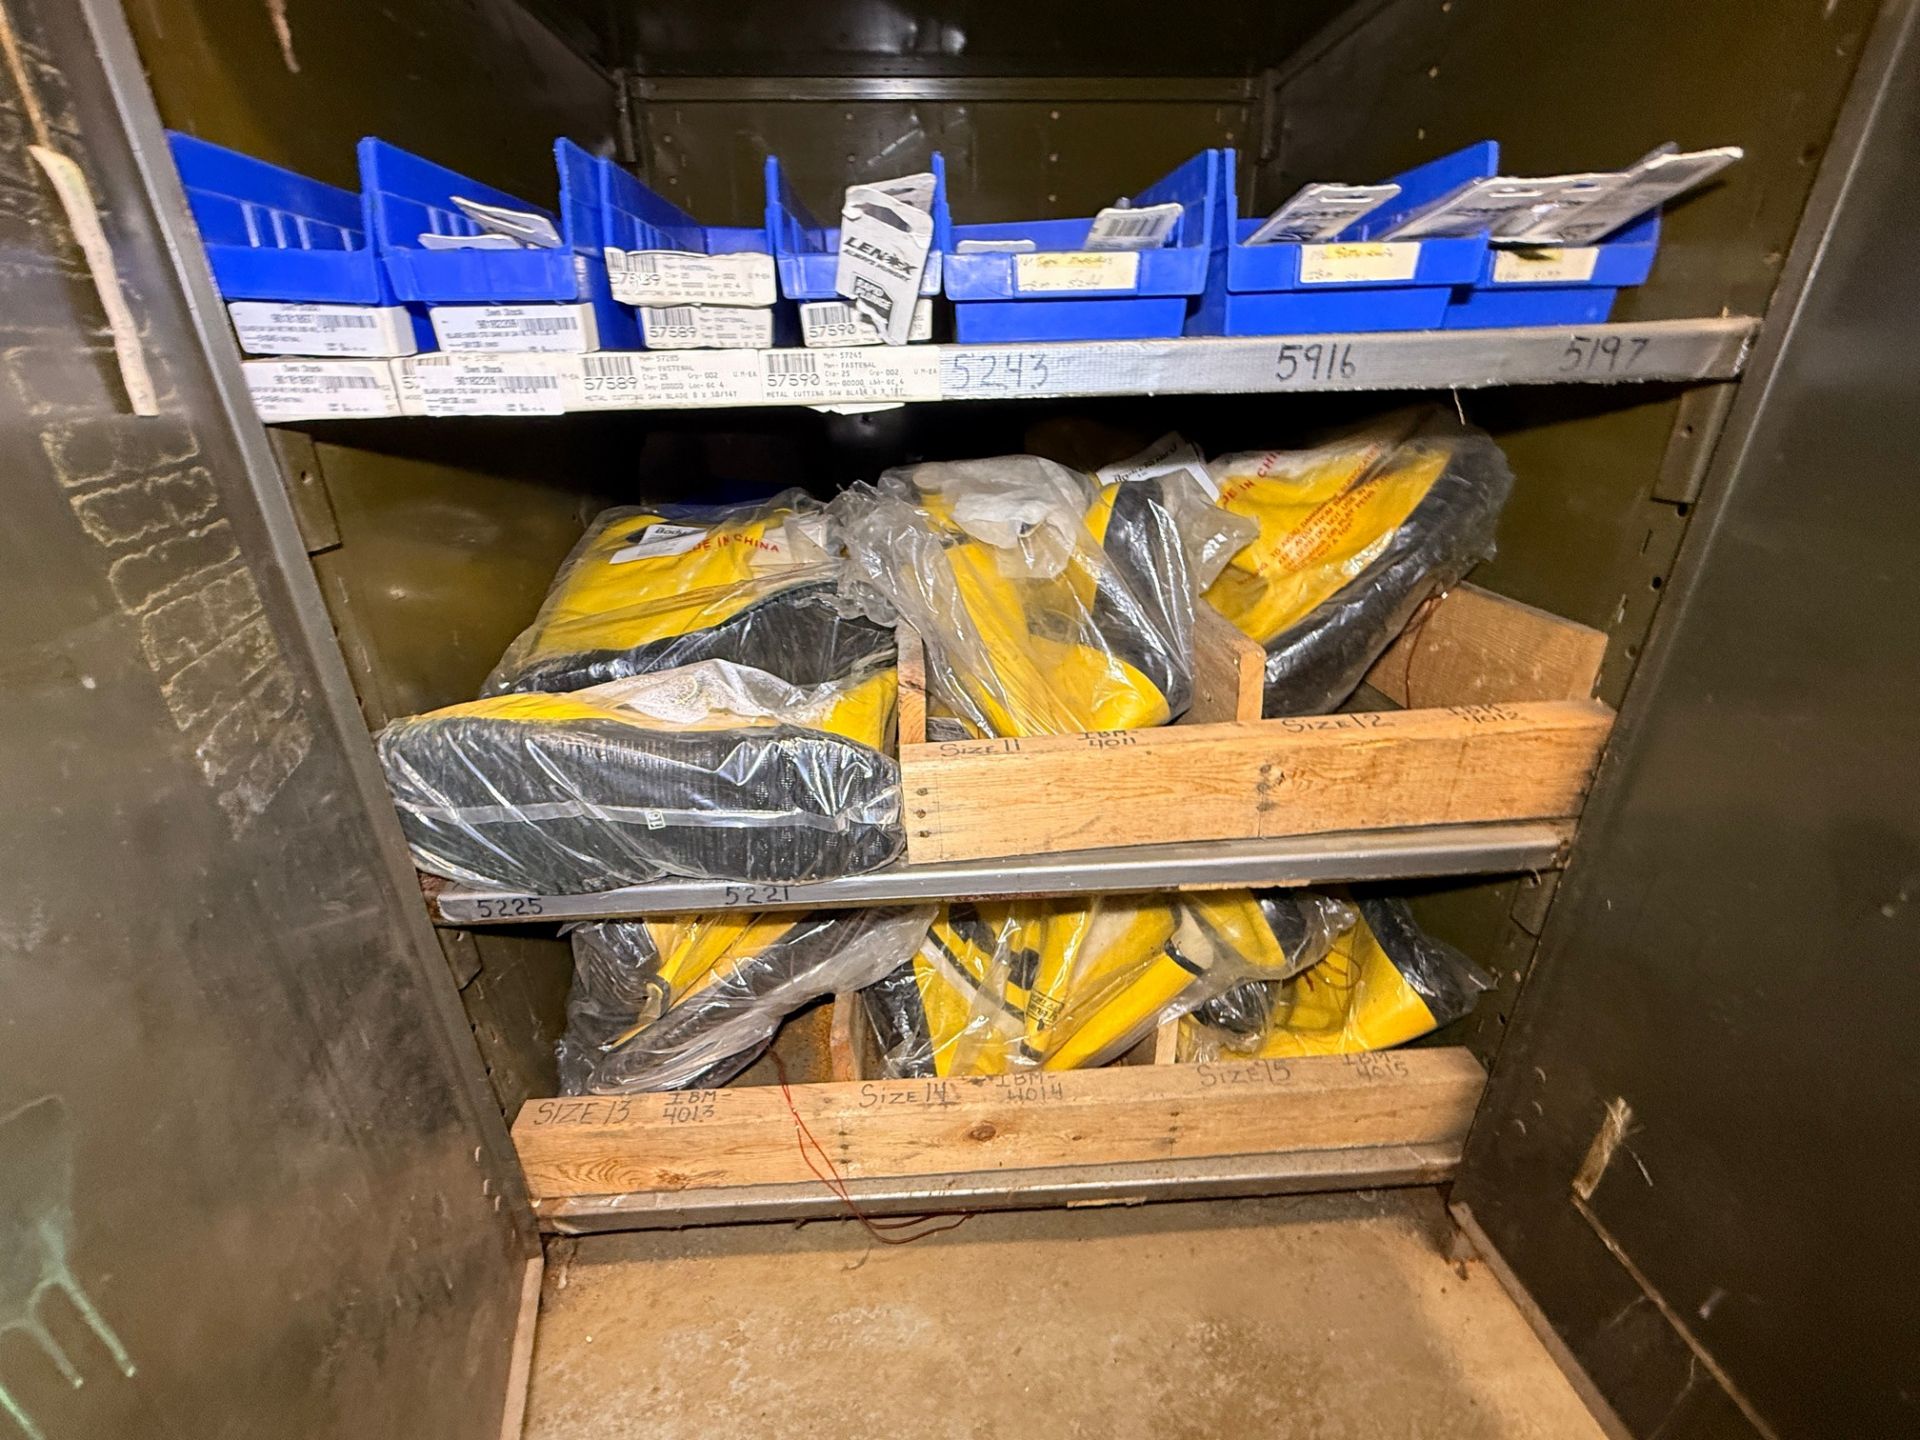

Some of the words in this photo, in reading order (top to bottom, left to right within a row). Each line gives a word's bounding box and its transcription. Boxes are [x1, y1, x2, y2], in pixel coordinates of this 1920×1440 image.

[650, 326, 697, 339] 57589
[1275, 343, 1355, 380] 5916
[1559, 336, 1649, 372] 5197
[767, 373, 820, 387] 57590
[951, 353, 1048, 390] 5243
[584, 376, 638, 390] 57589
[718, 534, 730, 547] IN
[734, 533, 780, 553] CHINA
[1004, 738, 1020, 752] 11
[725, 886, 790, 906] 5221
[475, 897, 544, 919] 5225
[1265, 1060, 1292, 1085] 15
[1355, 1061, 1409, 1082] 4015
[926, 1081, 947, 1106] 14
[1007, 1083, 1063, 1101] 4014
[534, 1101, 599, 1126] SIZE
[603, 1098, 631, 1125] 13
[663, 1104, 715, 1125] 4013
